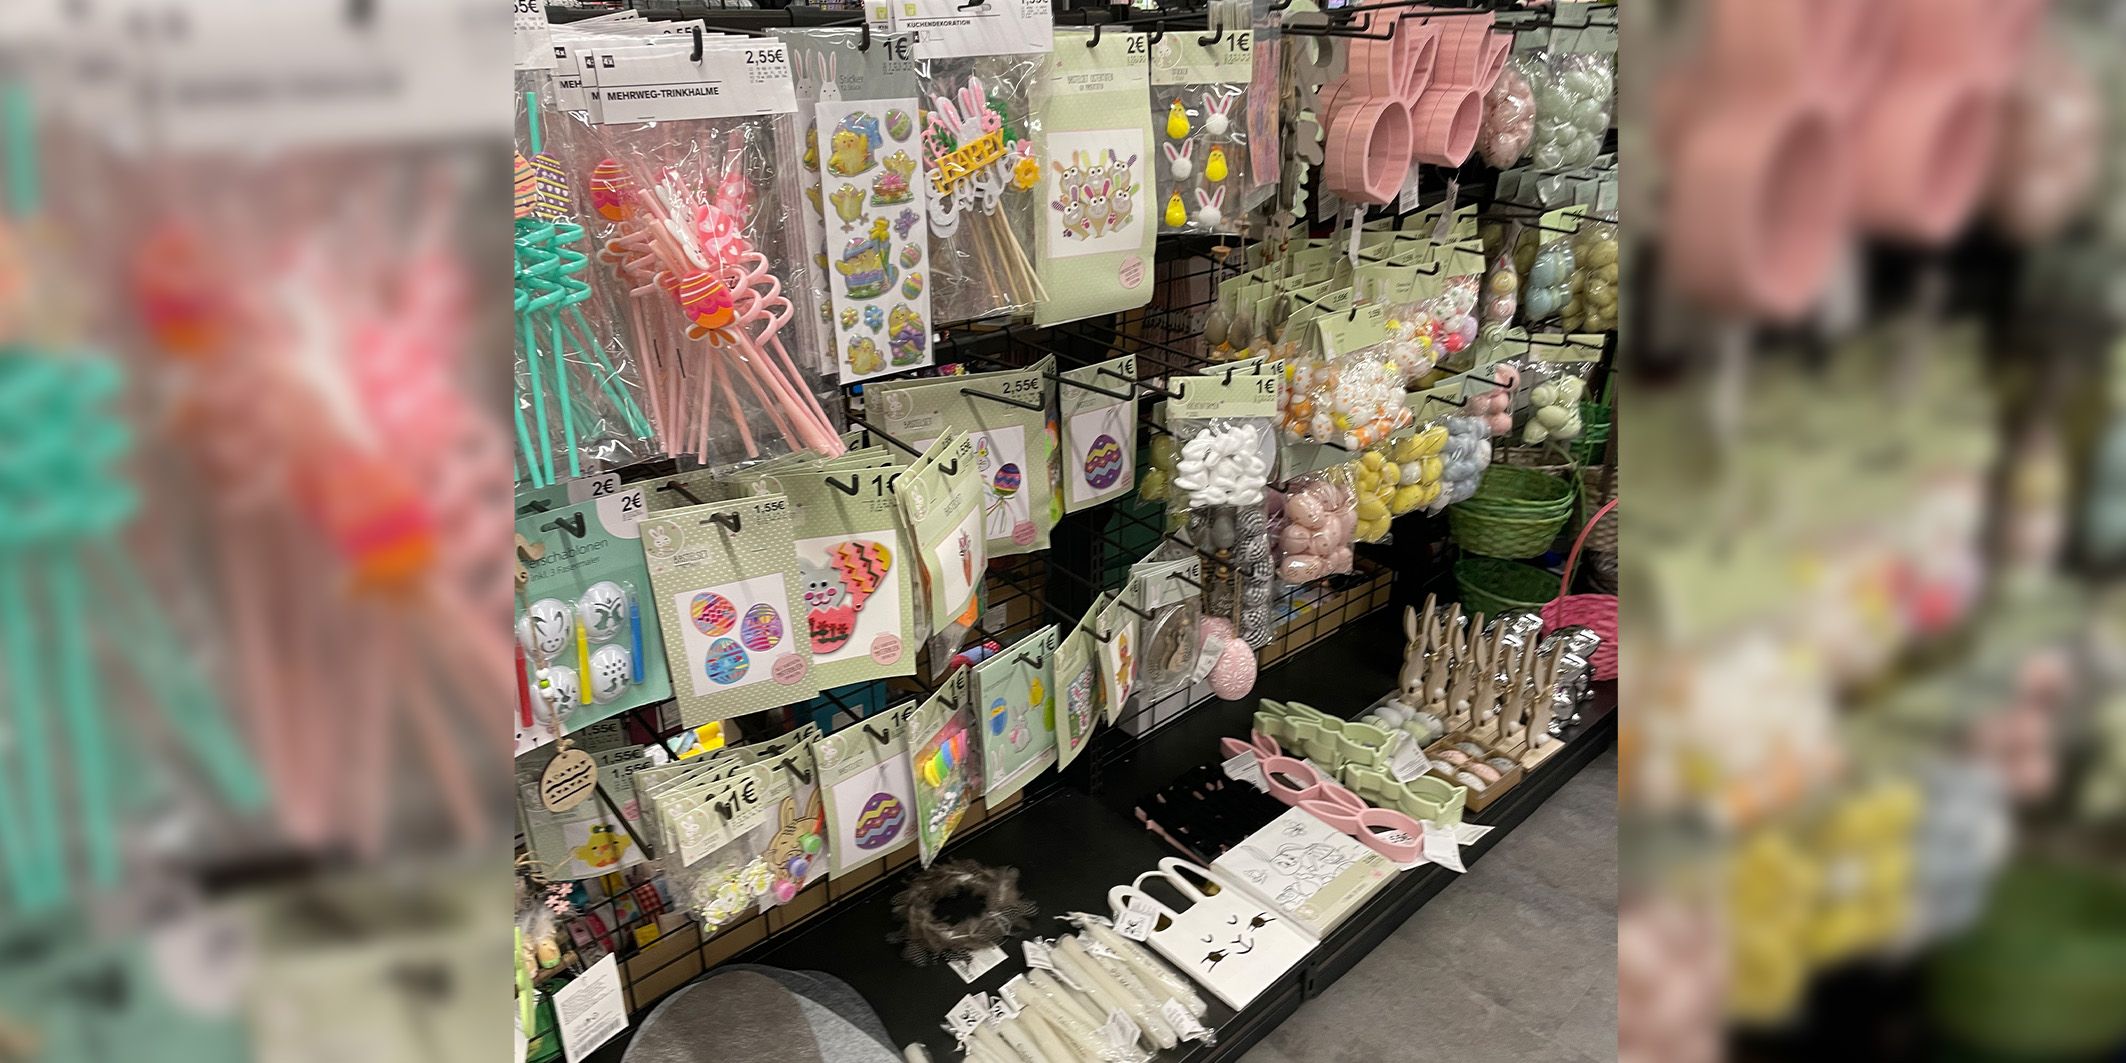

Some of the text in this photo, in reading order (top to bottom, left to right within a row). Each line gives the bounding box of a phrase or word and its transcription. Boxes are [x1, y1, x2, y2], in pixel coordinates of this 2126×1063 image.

[883, 38, 909, 60] 1€
[1126, 36, 1146, 54] 2€
[1226, 33, 1250, 52] 1€
[745, 49, 784, 66] 2,55€
[607, 86, 720, 101] MEHRWEG-TRINKHALME
[1116, 358, 1134, 376] 1€
[1270, 361, 1284, 376] 1€
[1002, 377, 1039, 395] 2,55€
[1256, 379, 1275, 394] 1€
[592, 478, 615, 497] 2€
[621, 492, 643, 513] 2€
[1037, 632, 1055, 657] 1€
[950, 670, 965, 698] 1€
[891, 706, 914, 728] 1€
[728, 780, 758, 812] 1€
